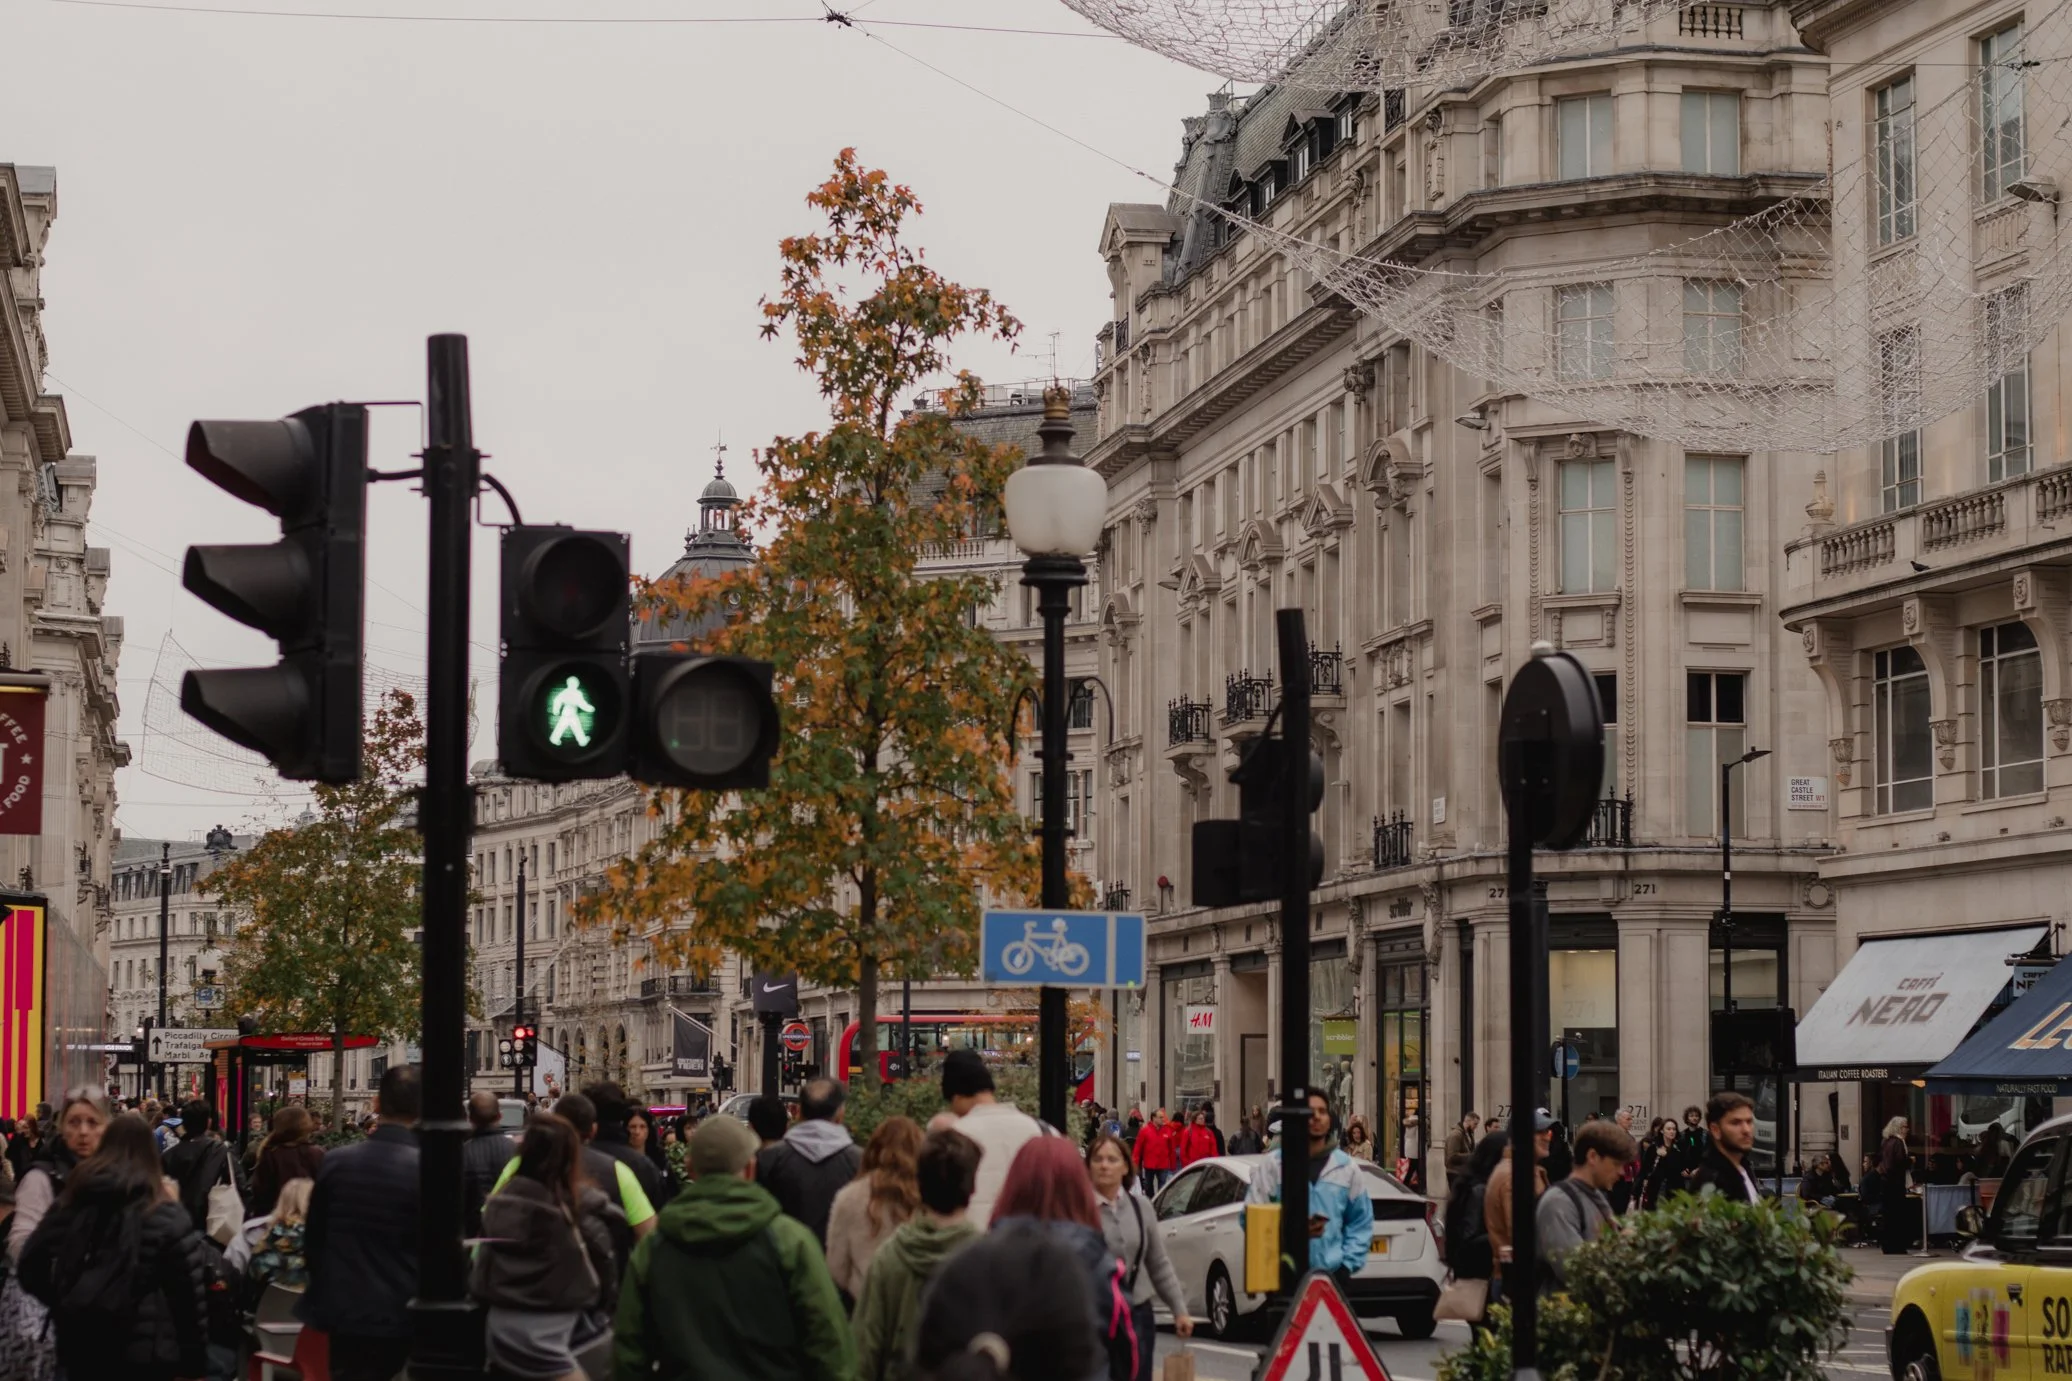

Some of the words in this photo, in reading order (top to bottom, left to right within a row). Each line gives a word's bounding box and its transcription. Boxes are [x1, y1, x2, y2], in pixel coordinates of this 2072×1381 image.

[3, 775, 30, 809] FOOD
[1489, 887, 1511, 898] 271
[1634, 884, 1656, 895] 271
[1846, 992, 1949, 1026] NERO
[1190, 1012, 1213, 1028] H&M
[165, 1032, 207, 1041] Piccadilly
[165, 1042, 201, 1051] Trafalga
[1818, 1070, 1838, 1079] ITALIAN
[1840, 1069, 1860, 1079] COFFEE
[1861, 1069, 1888, 1078] ROASTERS
[1996, 1083, 2025, 1093] NATURALLY
[2027, 1083, 2040, 1093] FAST
[2041, 1083, 2058, 1093] FOOD
[1497, 1104, 1512, 1118] 27
[2043, 1296, 2072, 1339] SO
